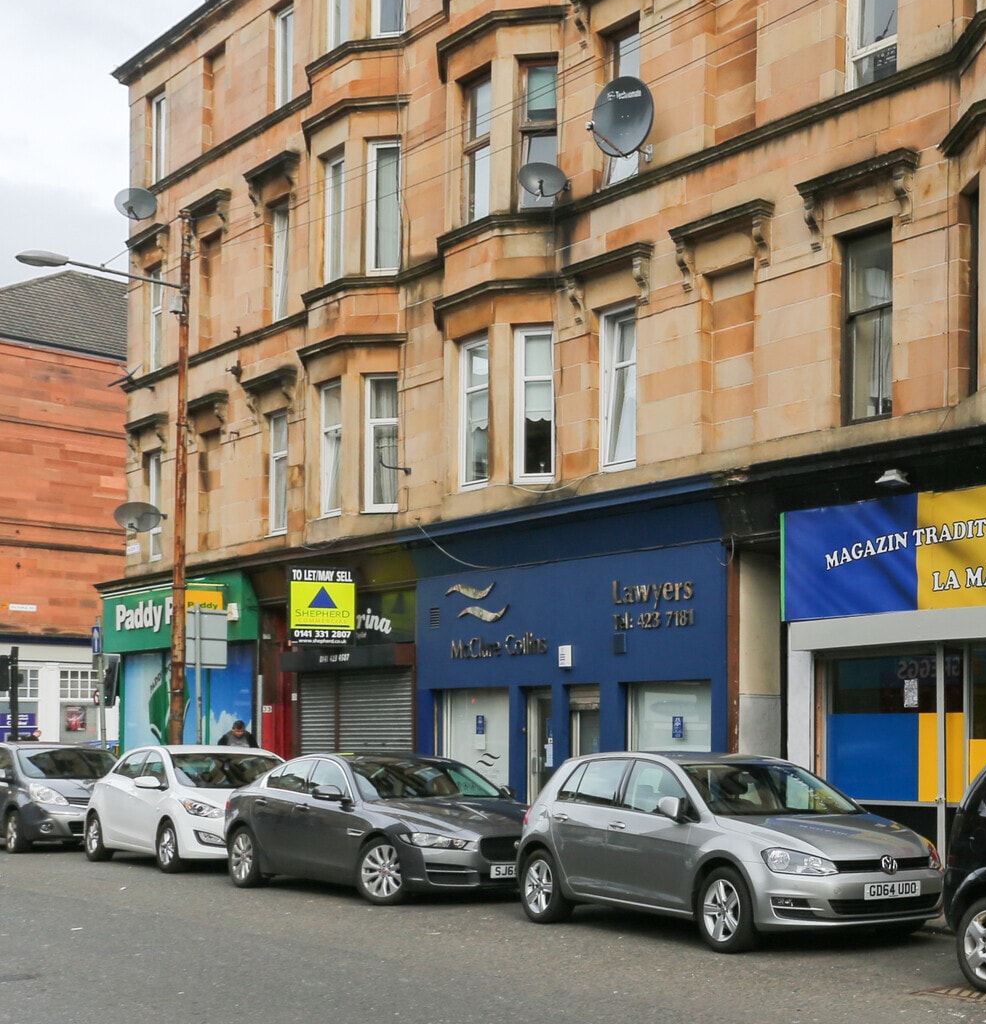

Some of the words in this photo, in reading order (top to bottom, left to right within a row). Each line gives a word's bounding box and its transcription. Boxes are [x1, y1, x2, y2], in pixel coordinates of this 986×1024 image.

[824, 531, 909, 571] MAGAZIN
[292, 569, 302, 580] TO
[304, 569, 335, 582] LET/MAY
[336, 571, 353, 582] SELL
[932, 568, 960, 591] LA
[187, 602, 218, 610] Pddy
[612, 580, 693, 610] Lawyers
[116, 600, 163, 633] Paddy
[295, 609, 350, 619] SHEPHERD
[356, 608, 392, 634] rina
[613, 611, 634, 630] Tel:
[637, 611, 661, 628] 423
[665, 609, 694, 627] 7181
[294, 630, 312, 638] 0141
[451, 637, 501, 660] McClure
[505, 632, 547, 656] Collins
[869, 884, 895, 897] GD64
[898, 882, 917, 895] UDO
